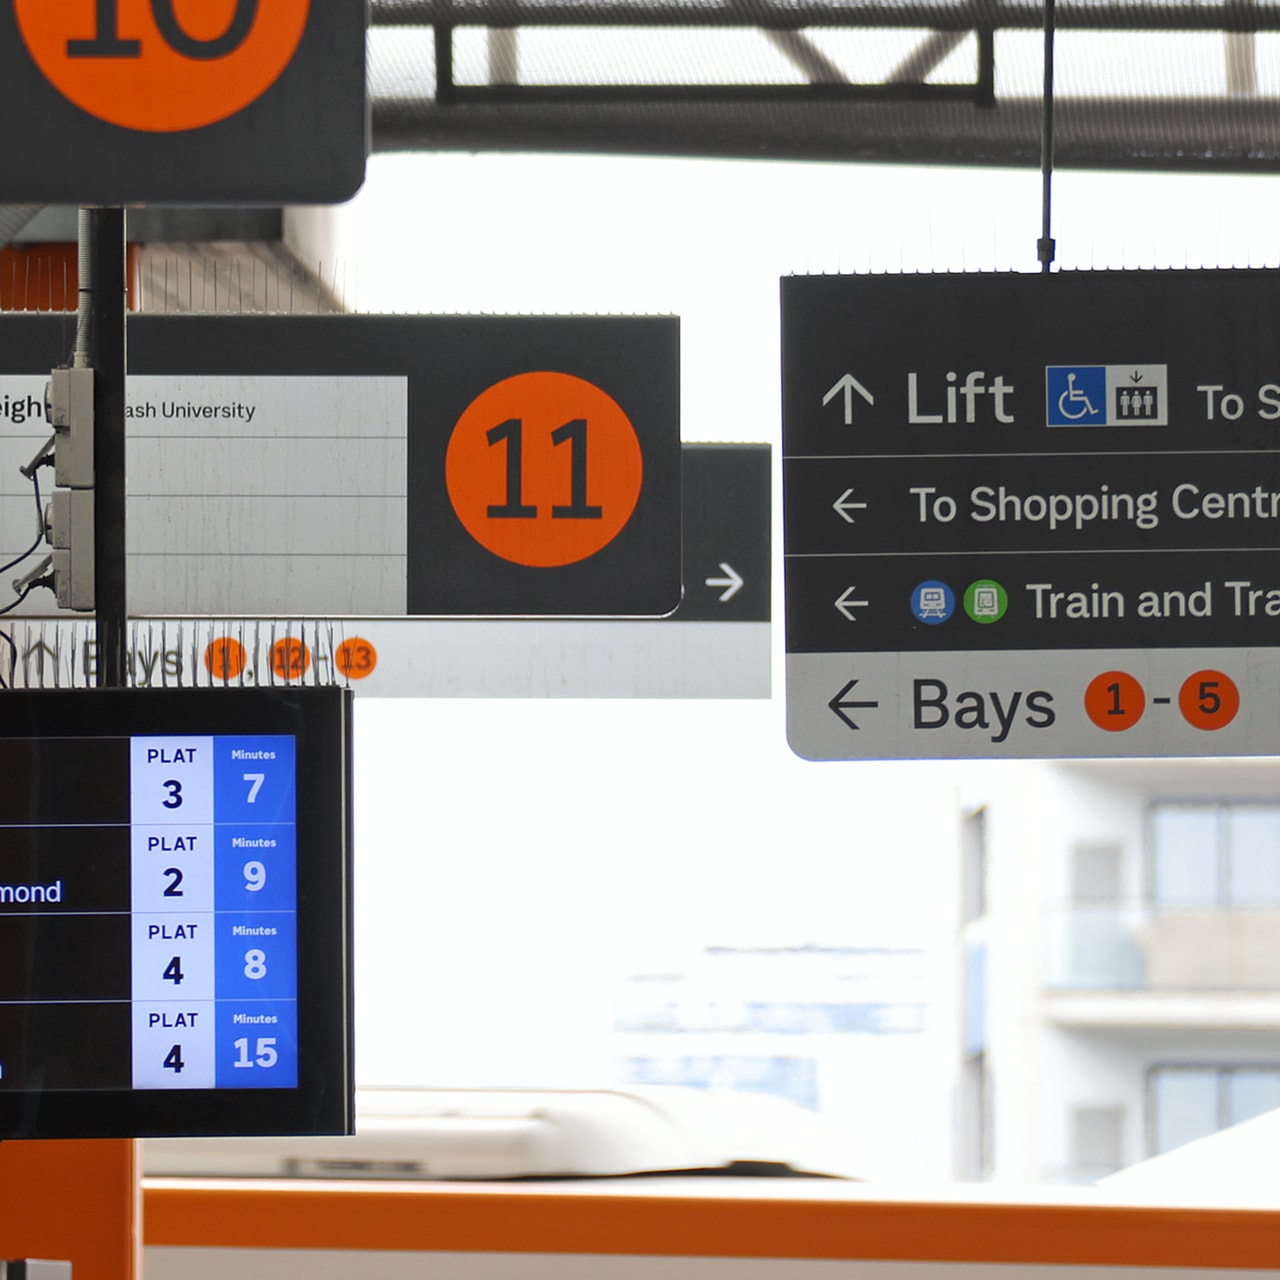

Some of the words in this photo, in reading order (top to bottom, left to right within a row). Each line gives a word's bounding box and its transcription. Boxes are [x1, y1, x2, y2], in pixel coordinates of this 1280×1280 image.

[124, 401, 157, 419] ash
[162, 401, 256, 423] University
[907, 371, 1015, 424] Lift
[1196, 385, 1244, 420] To
[485, 418, 603, 520] 11
[909, 487, 957, 523] To
[970, 484, 1159, 530] Shopping
[1025, 582, 1125, 619] Train
[1137, 581, 1212, 618] and
[340, 645, 373, 671] 13
[913, 678, 1056, 744] Bays
[1107, 683, 1126, 716] 1
[1199, 681, 1221, 714] 5
[147, 748, 197, 764] PLAT
[231, 749, 276, 760] Minutes
[162, 779, 183, 809] 3
[243, 773, 265, 804] 7
[148, 836, 198, 852] PLAT
[232, 837, 277, 848] Minutes
[163, 867, 184, 897] 2
[243, 860, 266, 892] 9
[148, 924, 198, 940] PLAT
[232, 925, 278, 936] Minutes
[162, 956, 184, 985] 4
[243, 948, 267, 980] 8
[149, 1012, 199, 1028] PLAT
[233, 1013, 278, 1024] Minutes
[163, 1044, 185, 1074] 4
[233, 1037, 278, 1068] 15
